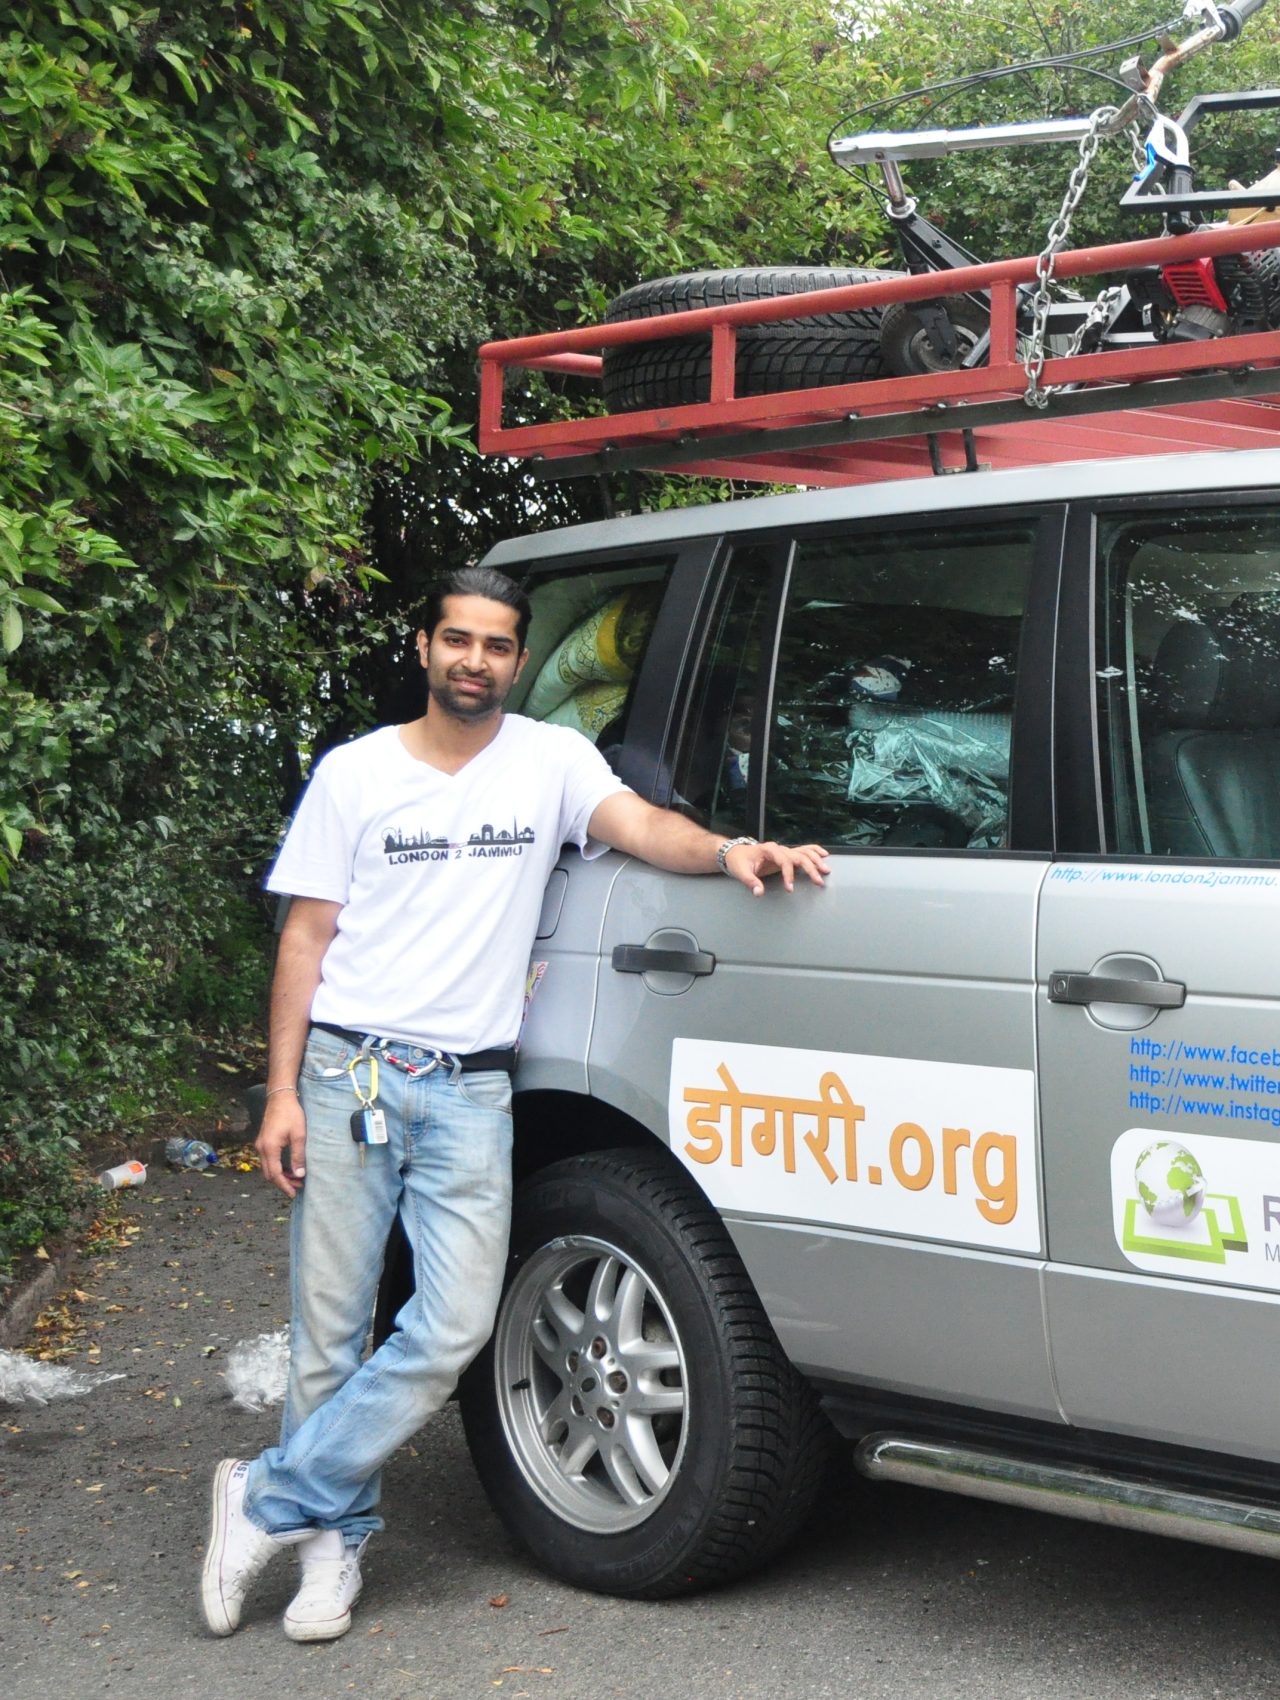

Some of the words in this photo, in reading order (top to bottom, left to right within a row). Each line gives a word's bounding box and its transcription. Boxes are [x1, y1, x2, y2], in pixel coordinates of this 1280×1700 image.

[388, 849, 449, 866] LONDON
[454, 849, 463, 860] 2
[468, 844, 523, 858] JAMMU
[683, 1062, 1018, 1225] डोगरी.org
